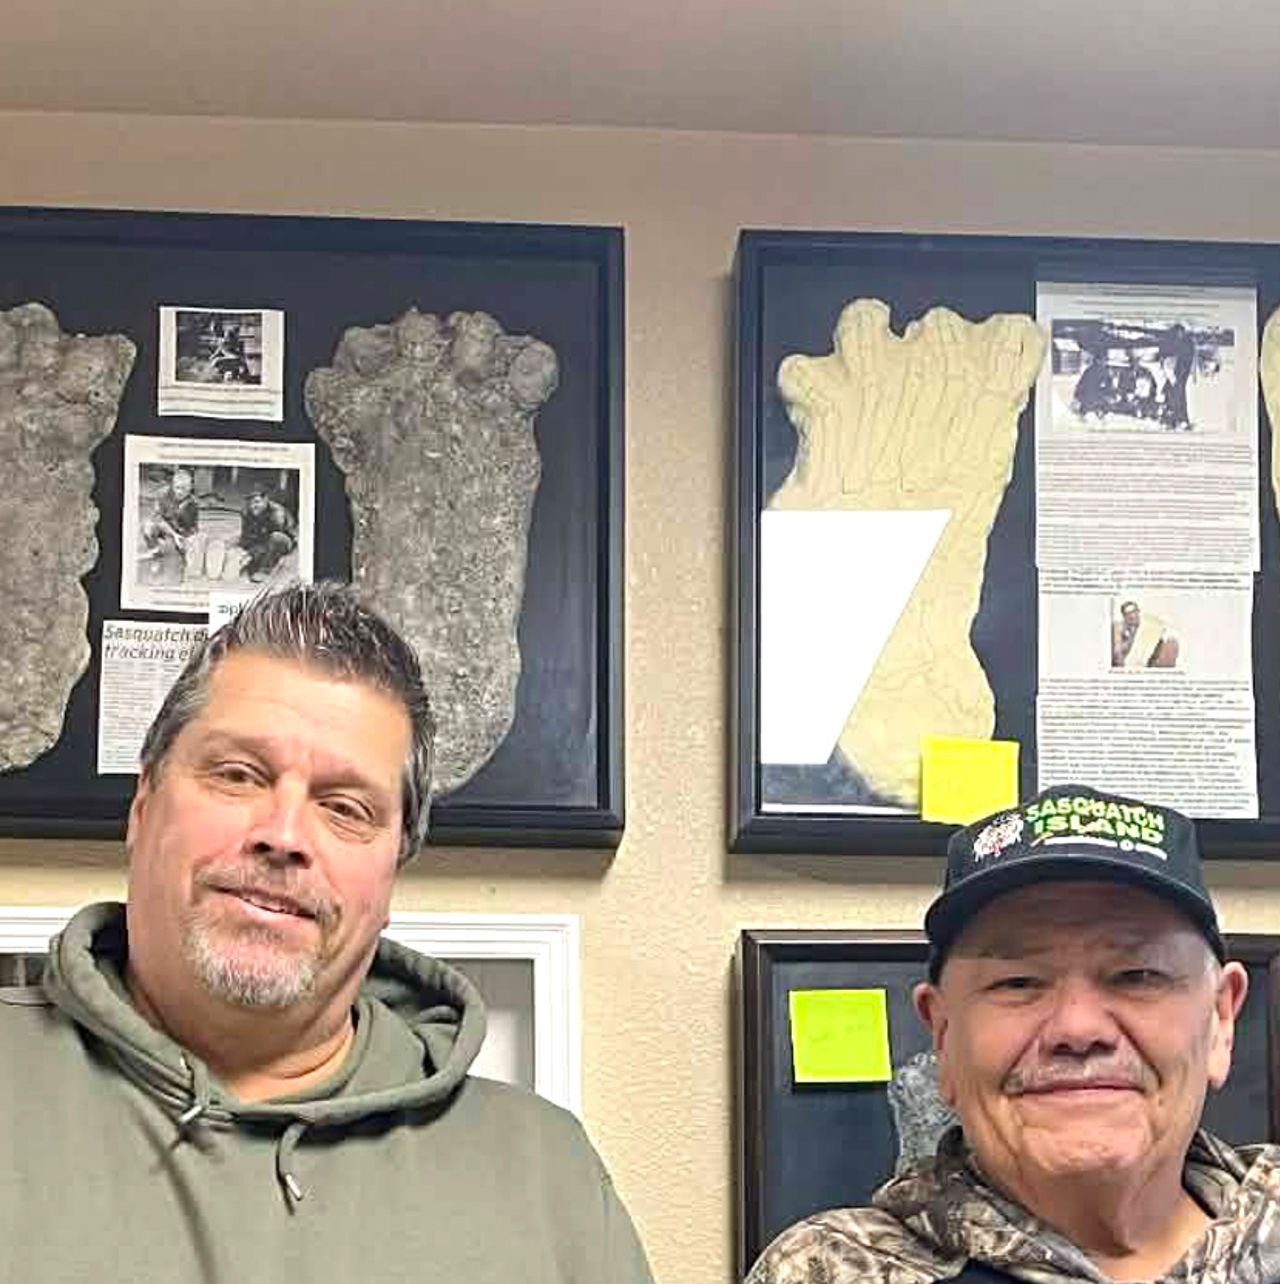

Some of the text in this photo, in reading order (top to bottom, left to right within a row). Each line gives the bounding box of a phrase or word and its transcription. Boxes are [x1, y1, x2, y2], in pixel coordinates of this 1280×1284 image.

[104, 623, 191, 643] Sasquatch
[105, 643, 176, 663] tracking
[1025, 796, 1165, 831] SASQUATCH
[1034, 814, 1164, 844] ISLAND
